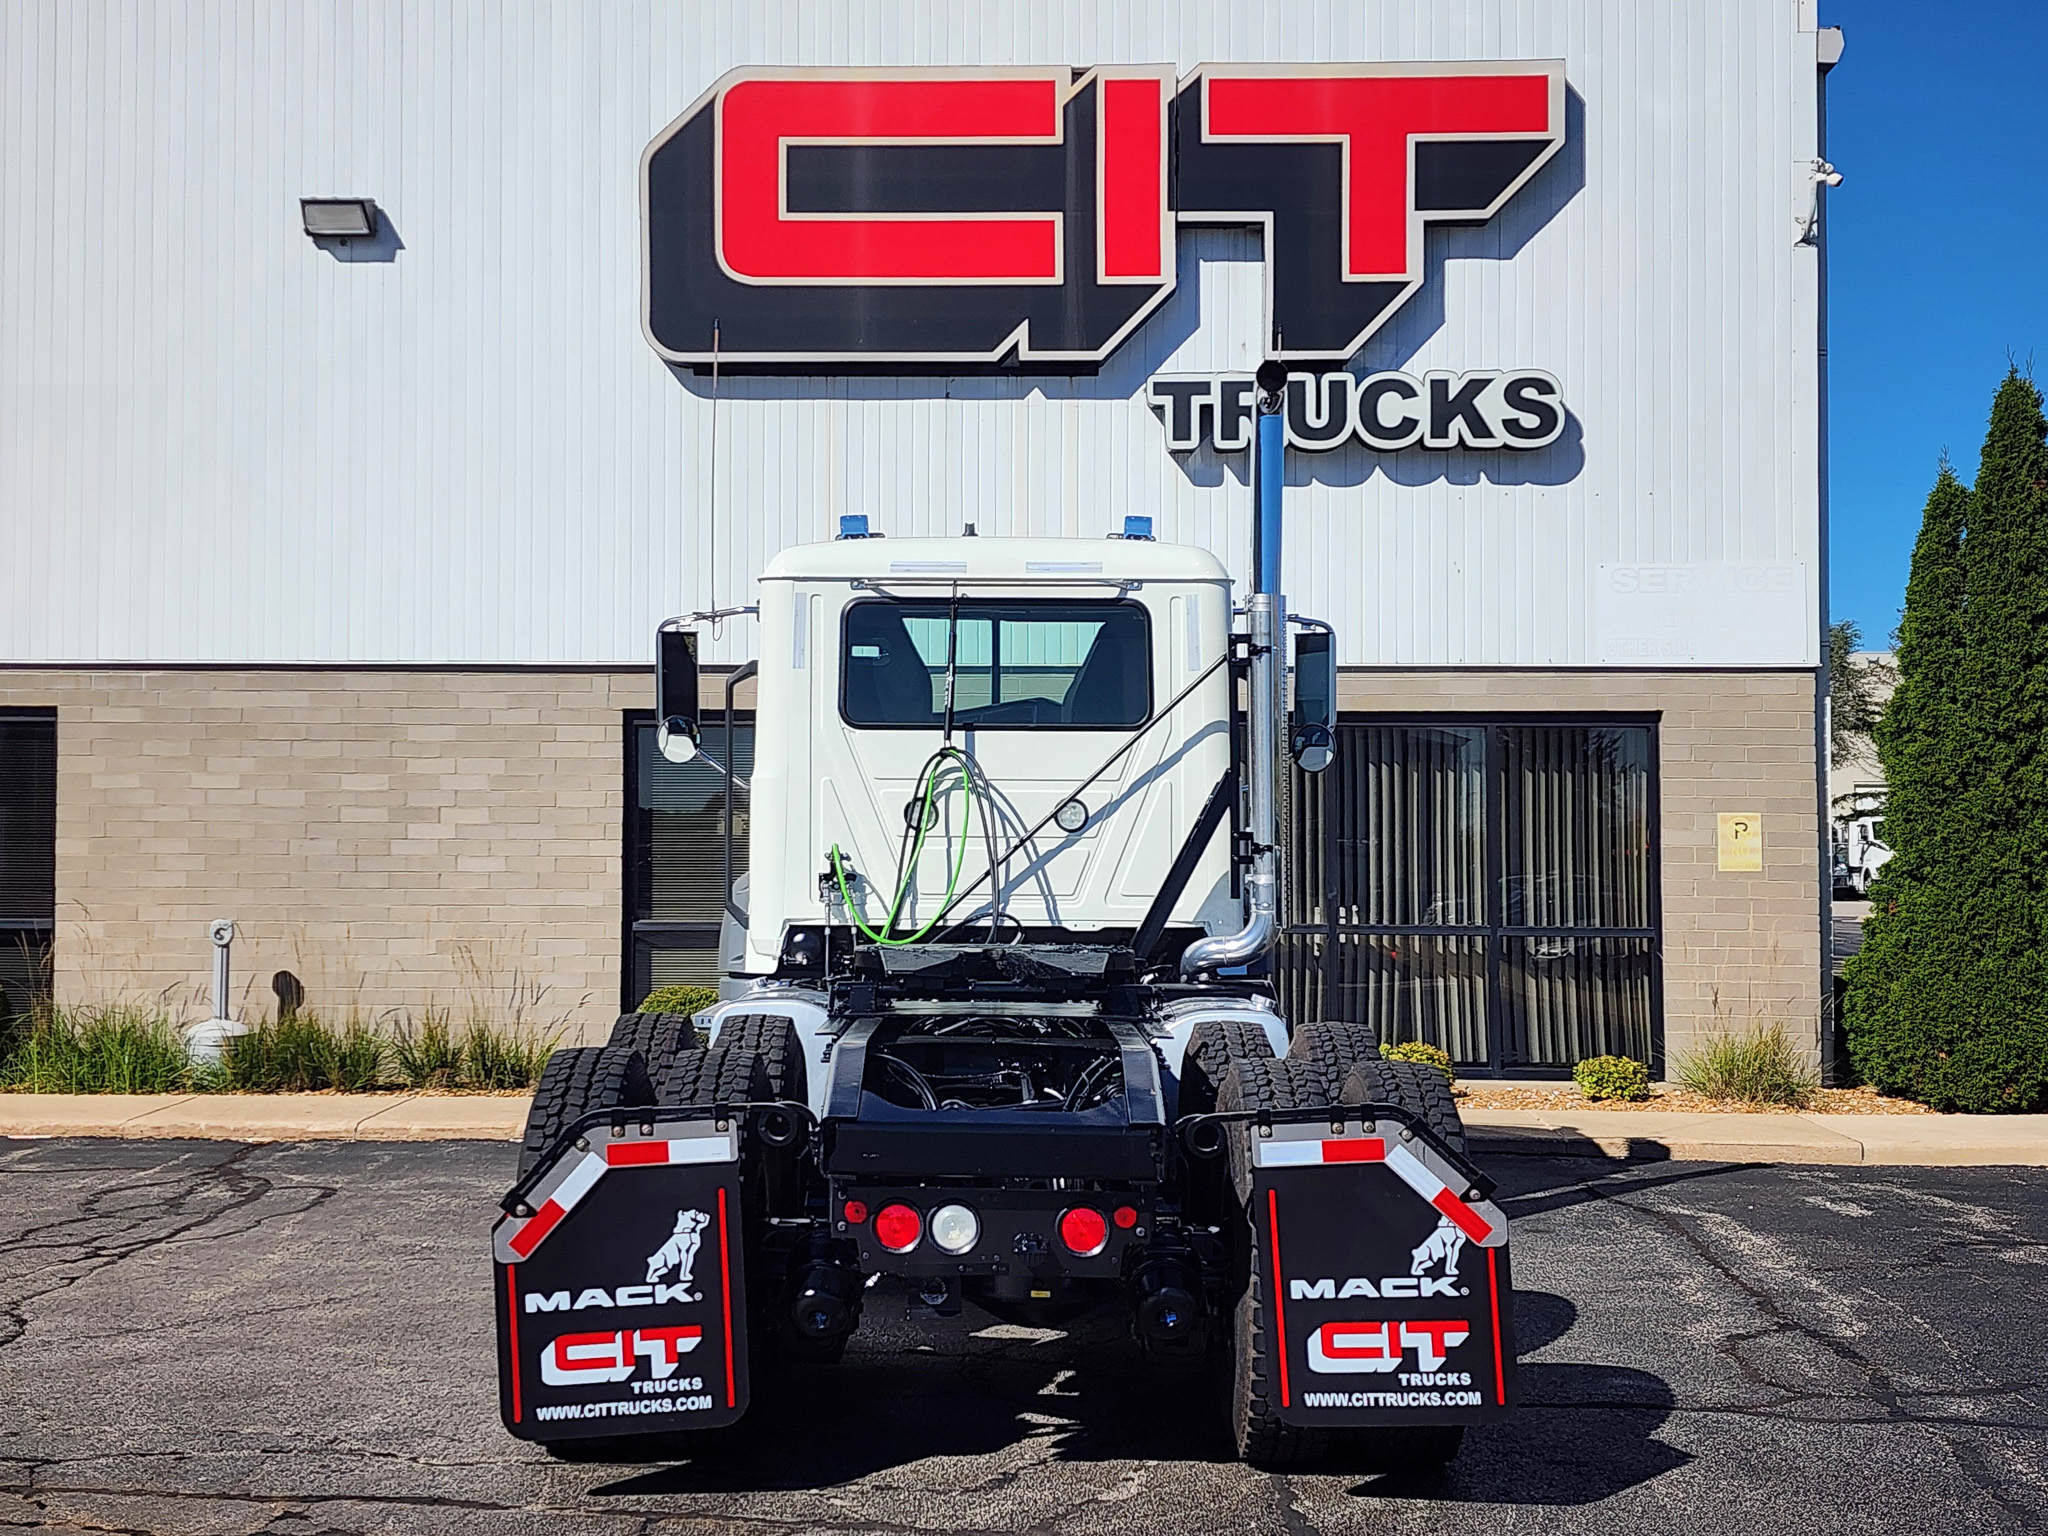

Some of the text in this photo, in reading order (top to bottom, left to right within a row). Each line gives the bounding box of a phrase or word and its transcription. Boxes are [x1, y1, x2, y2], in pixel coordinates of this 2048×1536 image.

[640, 60, 1566, 362] CIT
[1610, 566, 1793, 594] SERVICE
[1606, 637, 1659, 658] OTHER
[540, 1325, 702, 1386] CIT
[1307, 1320, 1469, 1373] CIT
[630, 1377, 702, 1394] TRUCKS
[1398, 1373, 1471, 1386] TRUCKS
[536, 1395, 712, 1421] WWW.CITTRUCKS.COM
[1304, 1391, 1481, 1407] WWW.CITTRUCKS.COM
